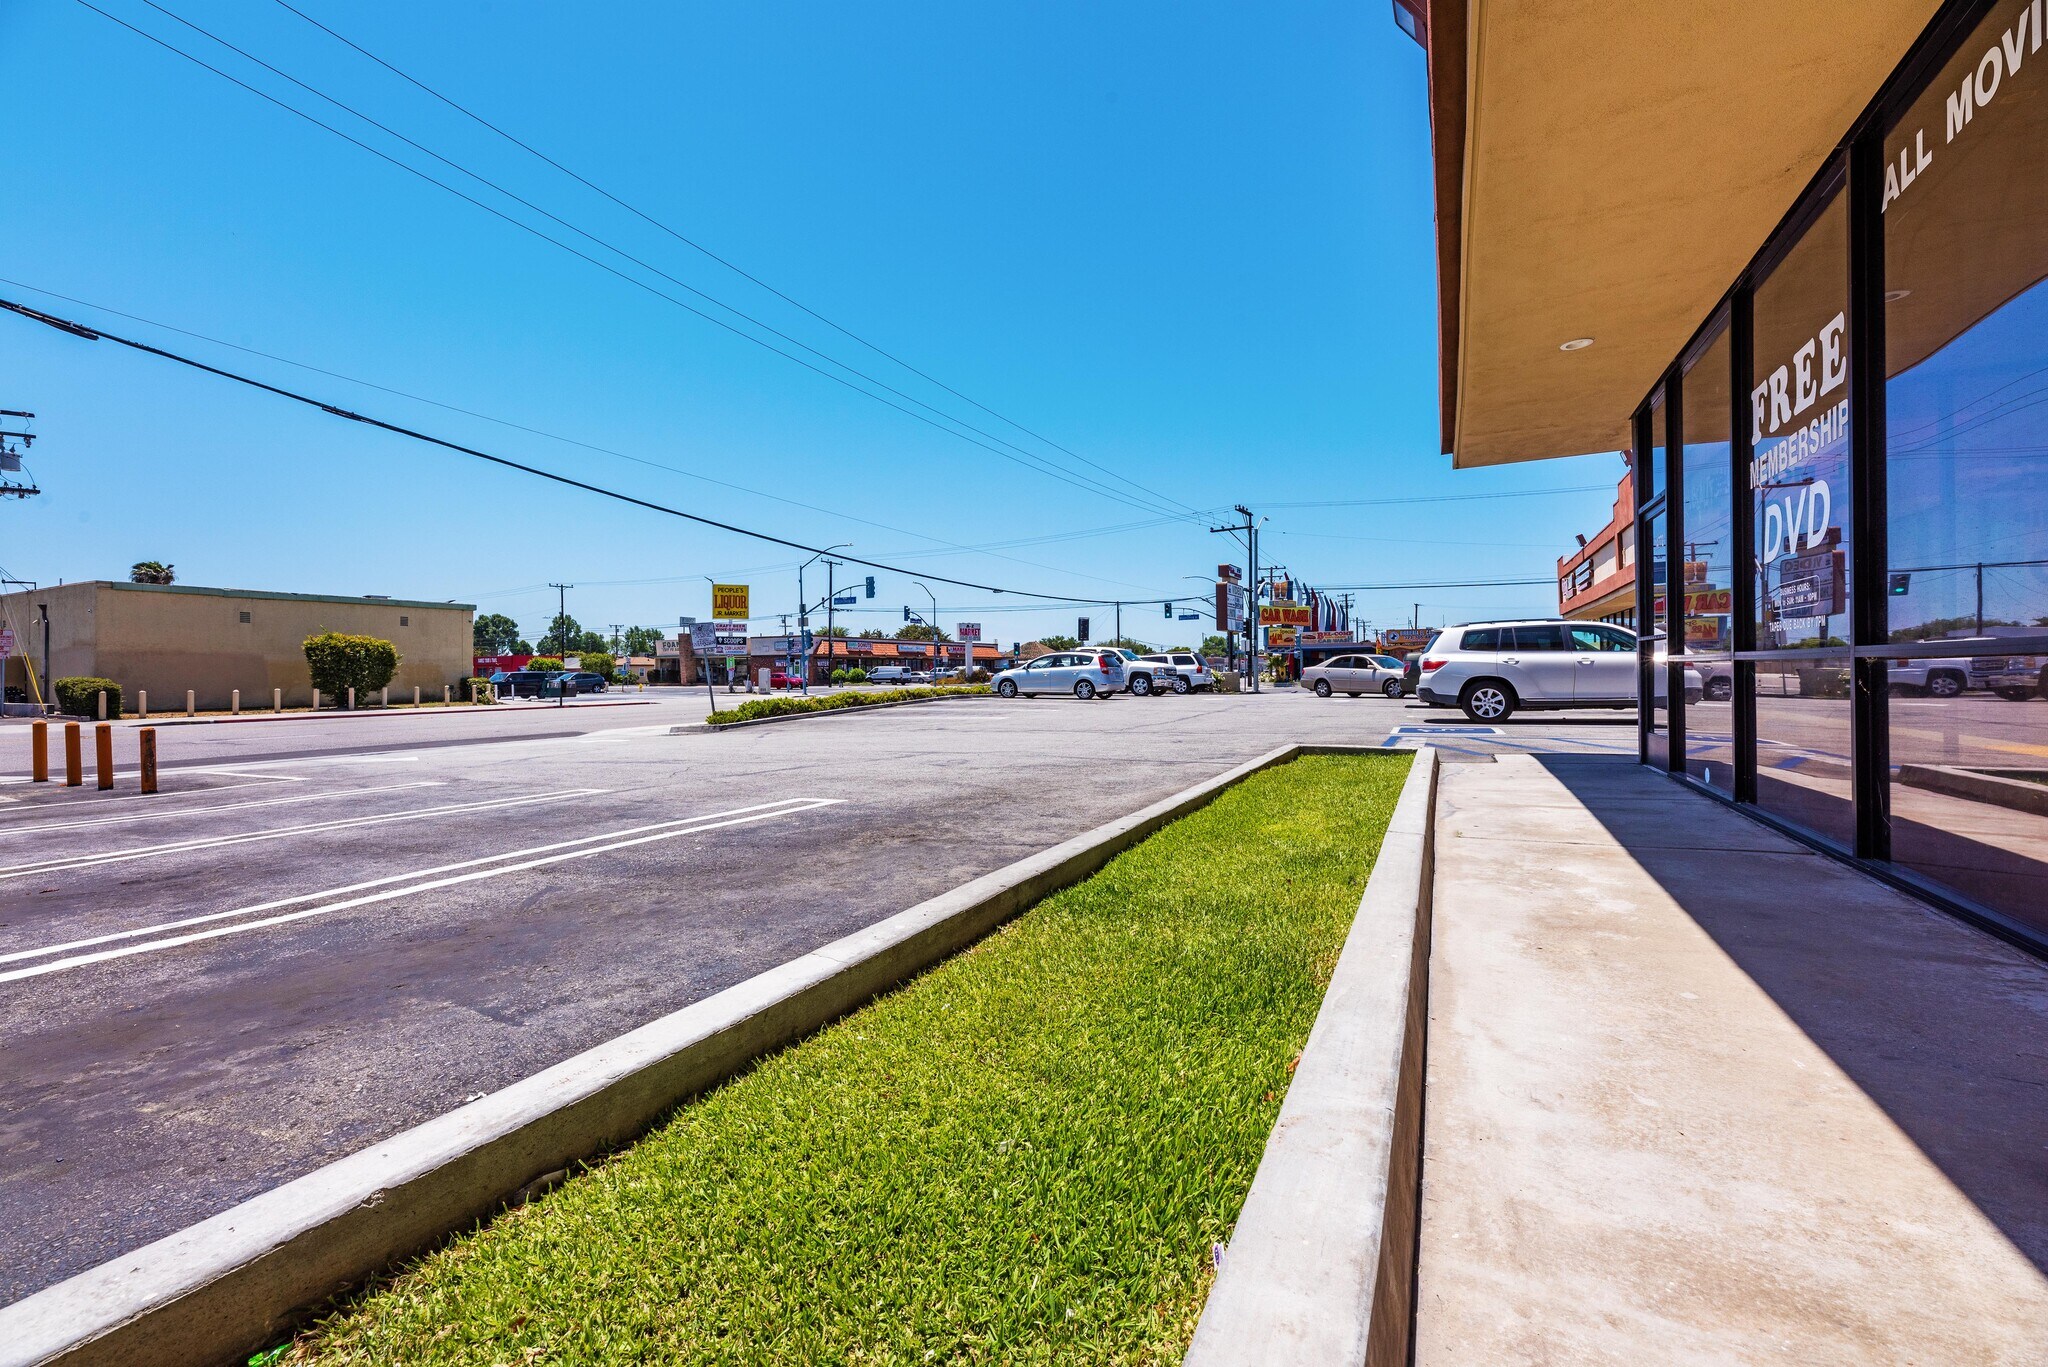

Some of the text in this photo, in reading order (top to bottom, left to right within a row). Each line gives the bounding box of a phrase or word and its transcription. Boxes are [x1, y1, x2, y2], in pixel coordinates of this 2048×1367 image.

[1881, 0, 2048, 214] ALL MOVI
[1751, 311, 1847, 446] FREE
[1750, 398, 1849, 490] MEMBERSHIP
[1764, 479, 1831, 564] DVD
[714, 595, 748, 610] LIQUOR
[1261, 608, 1309, 623] CAR WASH
[1780, 585, 1797, 596] BUSINESS
[959, 628, 981, 636] MARKET
